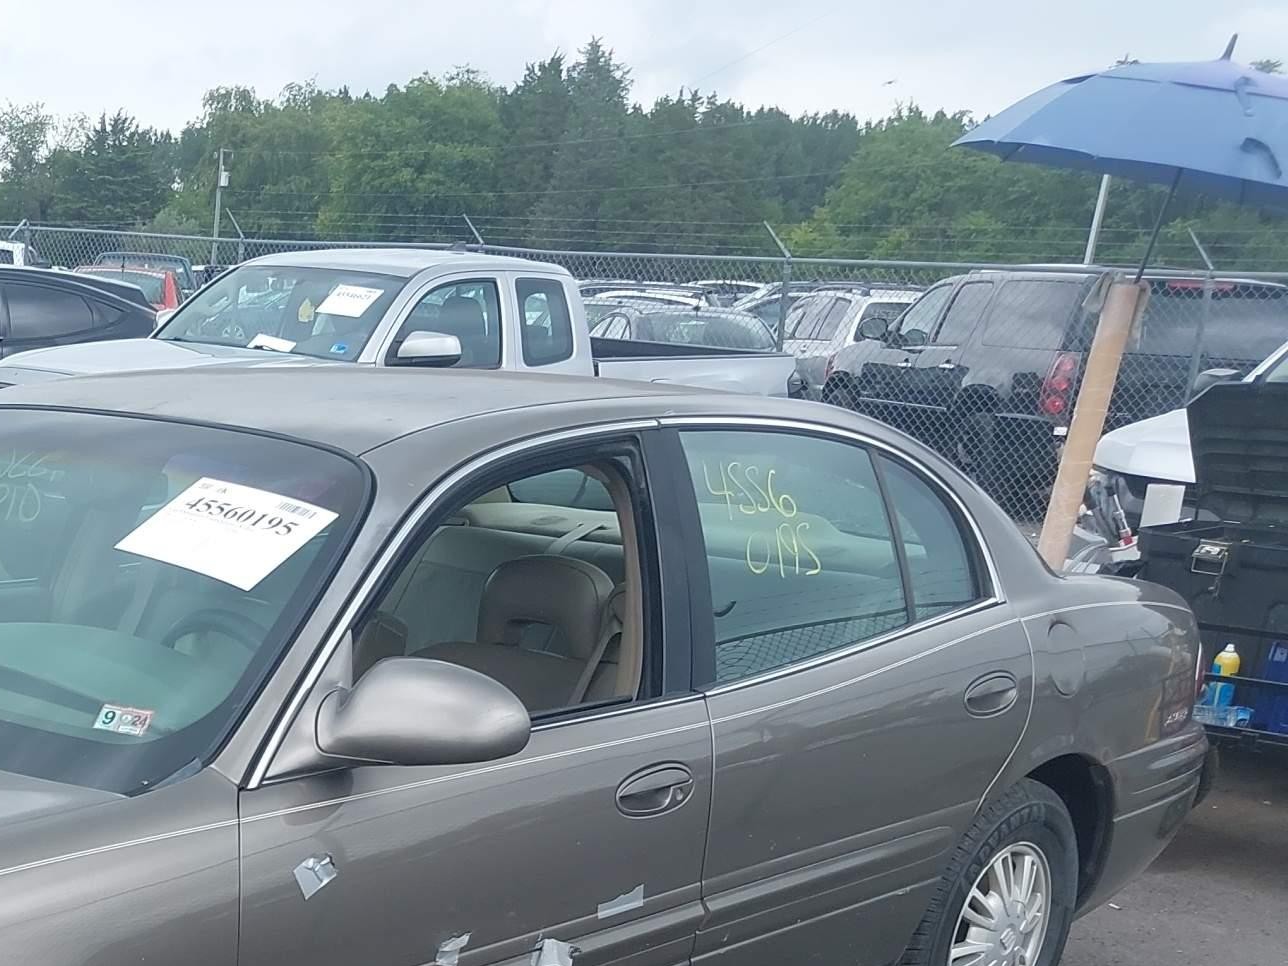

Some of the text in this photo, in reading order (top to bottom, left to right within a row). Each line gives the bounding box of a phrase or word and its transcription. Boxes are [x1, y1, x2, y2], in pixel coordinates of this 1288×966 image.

[703, 461, 797, 520] 4556
[185, 497, 300, 536] 45560195
[102, 710, 116, 725] 9
